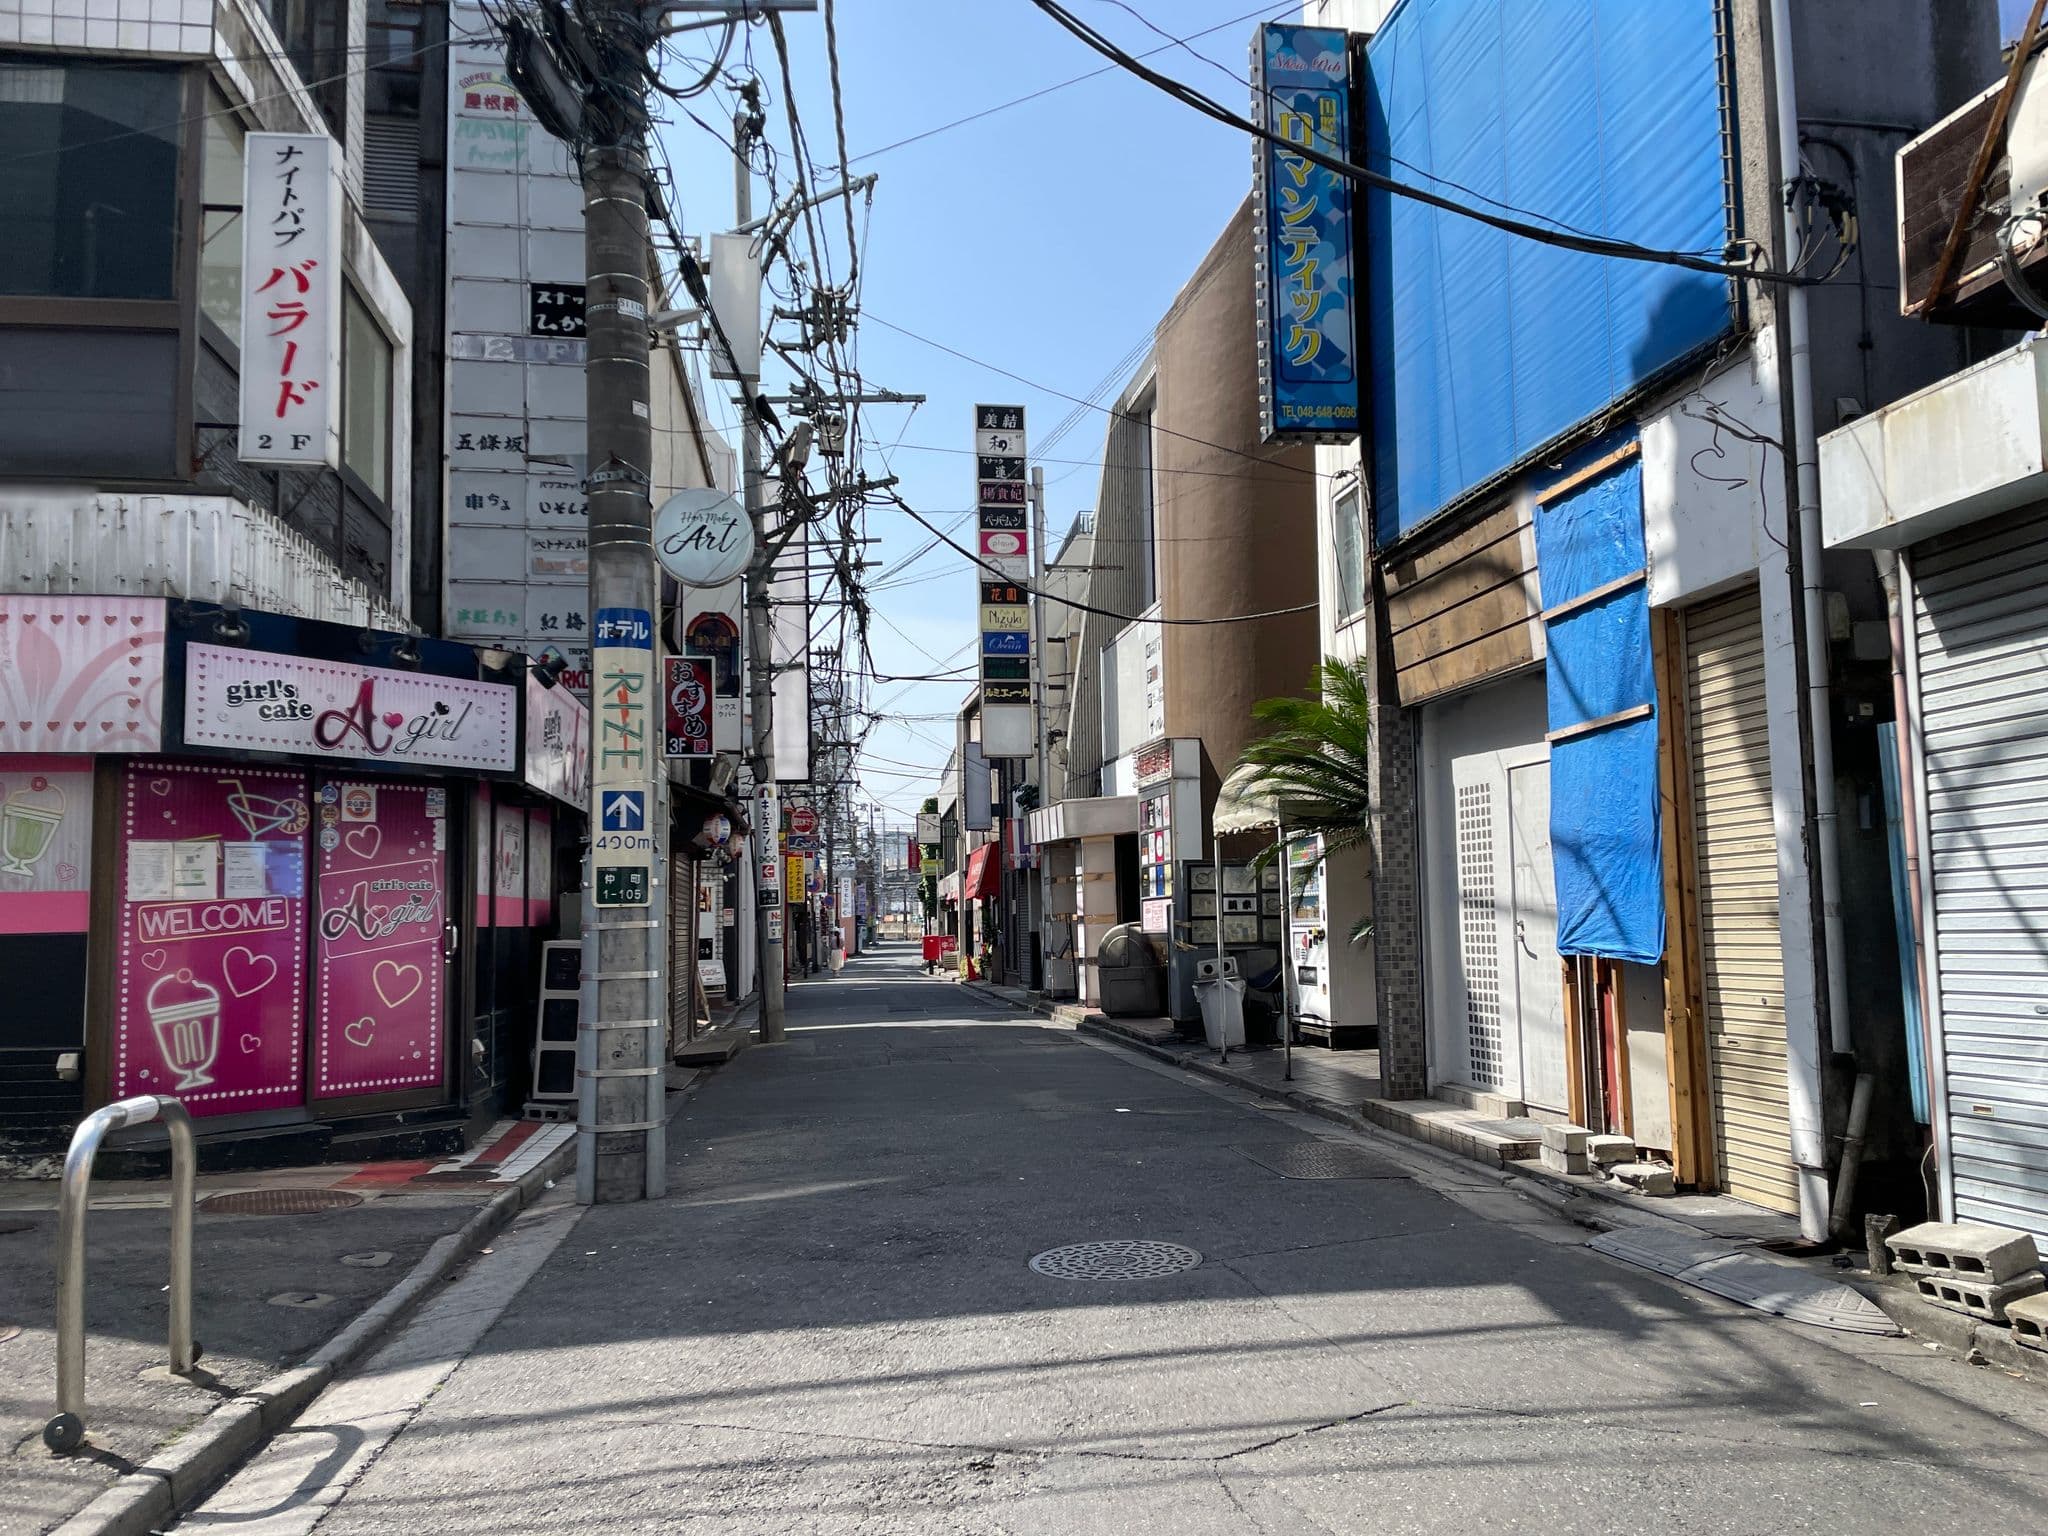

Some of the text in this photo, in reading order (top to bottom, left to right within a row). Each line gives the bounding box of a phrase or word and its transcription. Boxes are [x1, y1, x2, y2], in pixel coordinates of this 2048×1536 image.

[1272, 52, 1342, 73] Show Pub
[275, 146, 305, 248] ナイトパブ
[1279, 111, 1321, 366] ロマンティック
[254, 259, 320, 418] バラード
[1281, 405, 1297, 418] TEL
[663, 517, 738, 554] Art
[598, 620, 649, 640] ホテル
[227, 680, 298, 704] girl's
[671, 661, 707, 738] おすすめ
[259, 700, 313, 719] cafe
[313, 677, 393, 757] A
[393, 700, 473, 753] girl
[669, 737, 686, 753] 3F
[371, 880, 433, 892] girl's cafe
[602, 889, 642, 900] 1-105
[141, 899, 285, 938] WELCOME
[320, 881, 440, 940] A girl
